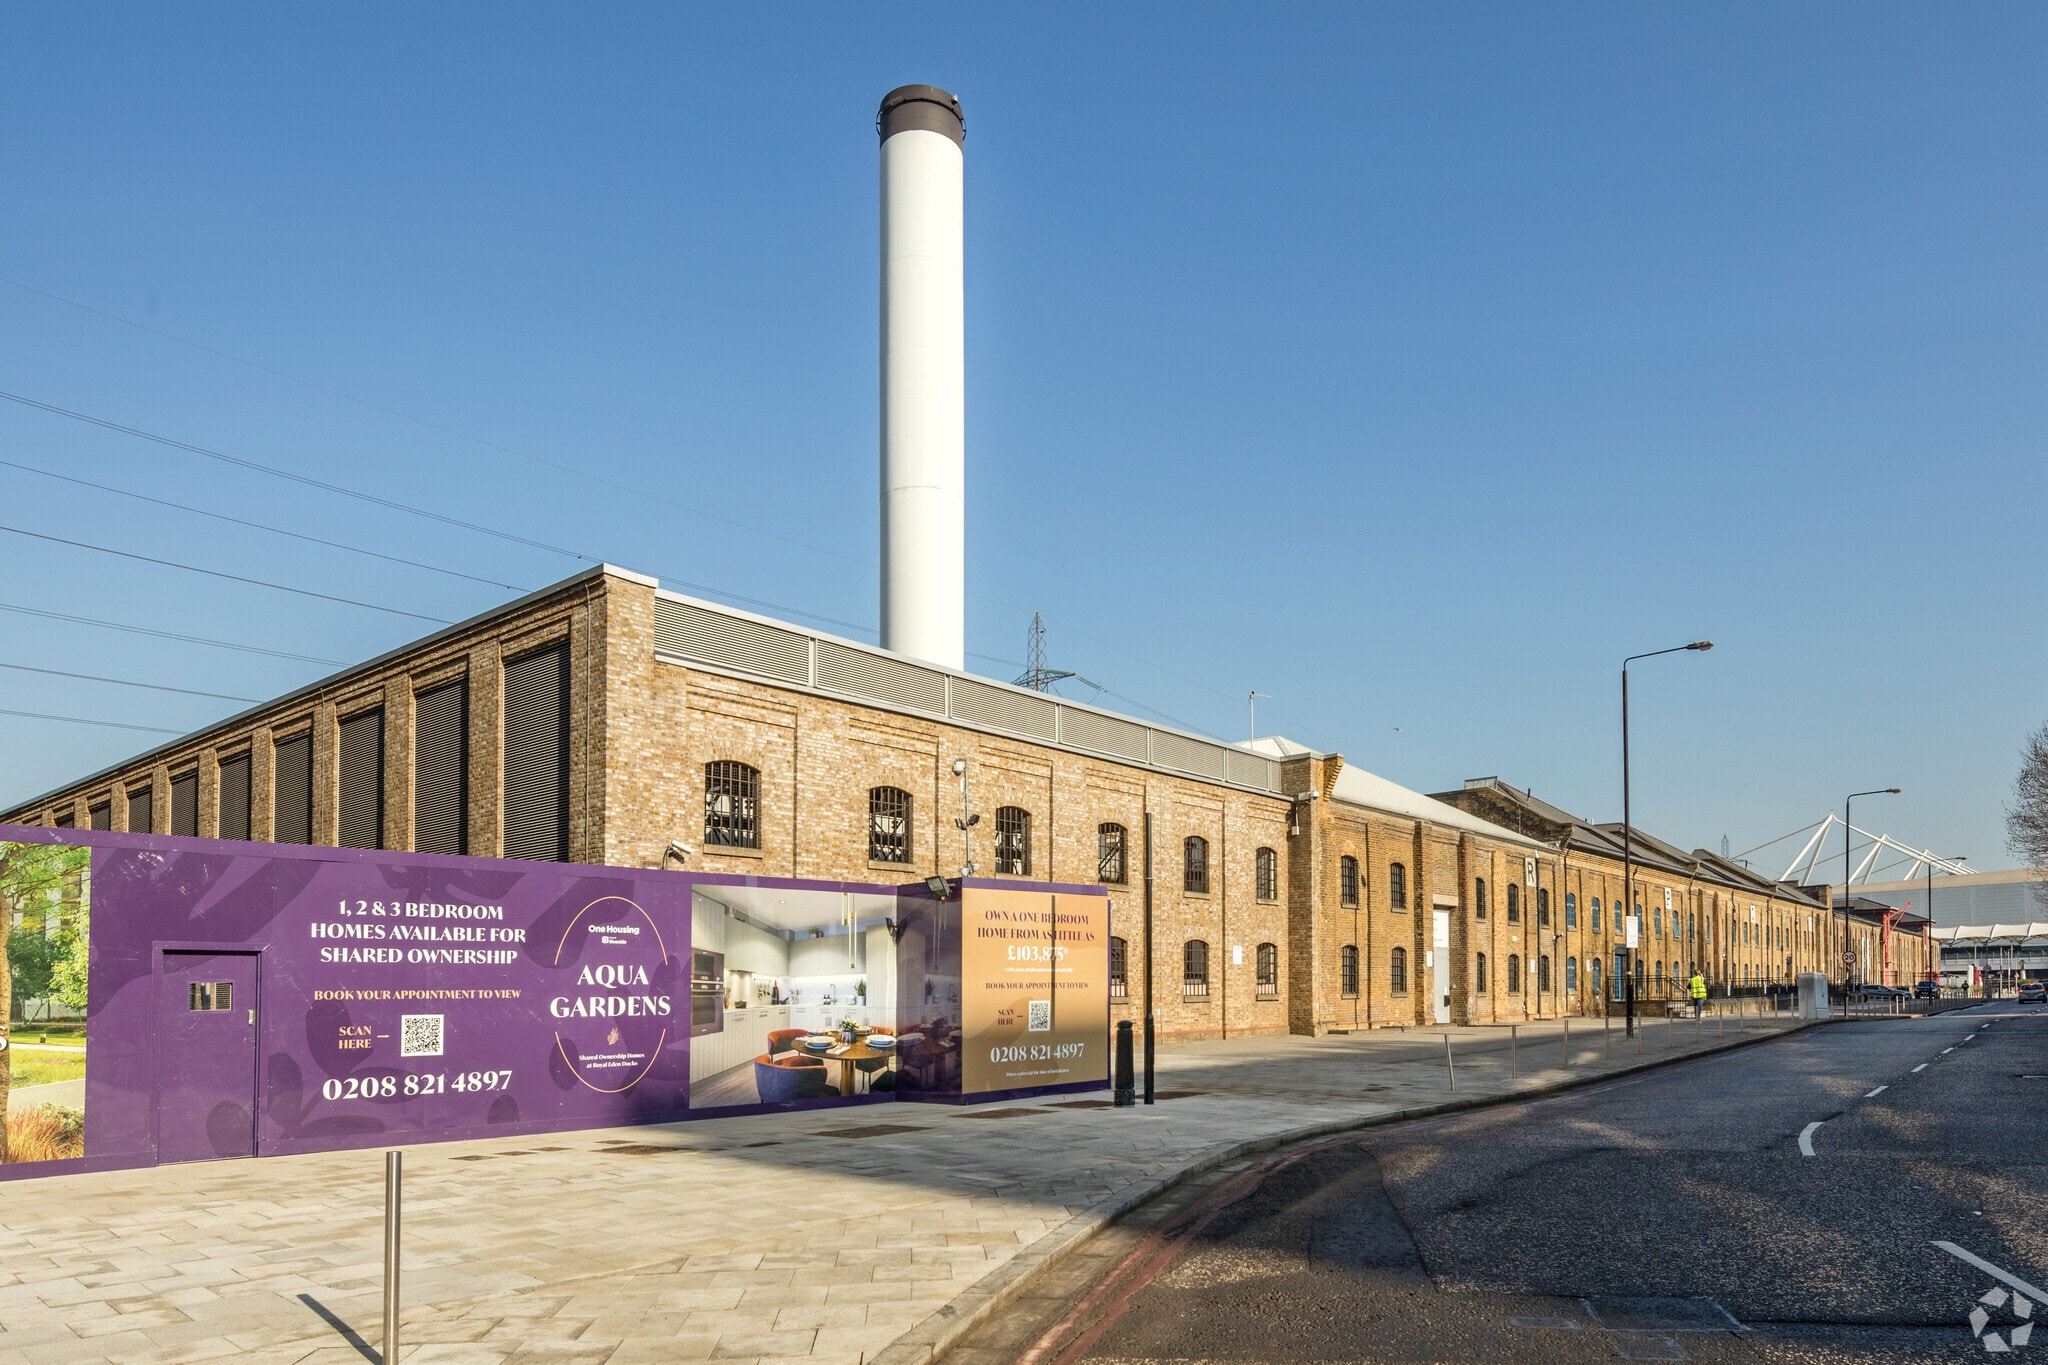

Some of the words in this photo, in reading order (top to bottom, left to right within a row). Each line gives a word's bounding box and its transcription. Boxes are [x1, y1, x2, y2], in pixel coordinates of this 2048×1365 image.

[1528, 862, 1534, 883] R
[340, 900, 352, 917] 1,
[356, 900, 367, 915] 2
[372, 901, 386, 916] &
[390, 902, 400, 916] 3
[406, 902, 504, 920] BEDROOM
[985, 910, 1009, 921] OWN
[1011, 911, 1018, 922] A
[1020, 912, 1040, 923] ONE
[1042, 913, 1089, 924] BEDROOM
[311, 922, 386, 940] HOMES
[389, 925, 486, 942] AVAILABLE
[490, 928, 526, 942] FOR
[588, 924, 606, 932] One
[606, 926, 640, 935] Housing
[978, 927, 1008, 939] HOME
[1011, 928, 1040, 940] FROM
[1040, 930, 1052, 940] AS
[1053, 930, 1082, 941] LITTLE
[1085, 932, 1095, 942] AS
[320, 946, 403, 964] SHARED
[408, 948, 518, 964] OWNERSHIP
[576, 964, 650, 988] AQUA
[314, 990, 354, 1000] BOOK
[356, 990, 391, 1000] YOUR
[393, 990, 476, 1000] APPOINTMENT
[478, 990, 492, 998] TO
[495, 989, 522, 998] VIEW
[550, 996, 671, 1018] GARDENS
[338, 1026, 372, 1036] SCAN
[338, 1039, 372, 1050] HERE
[990, 1046, 1027, 1063] 0208
[1030, 1044, 1051, 1060] 821
[1054, 1043, 1084, 1058] 4897
[322, 1076, 397, 1100] 0208
[404, 1074, 445, 1096] 821
[451, 1070, 512, 1092] 4897
